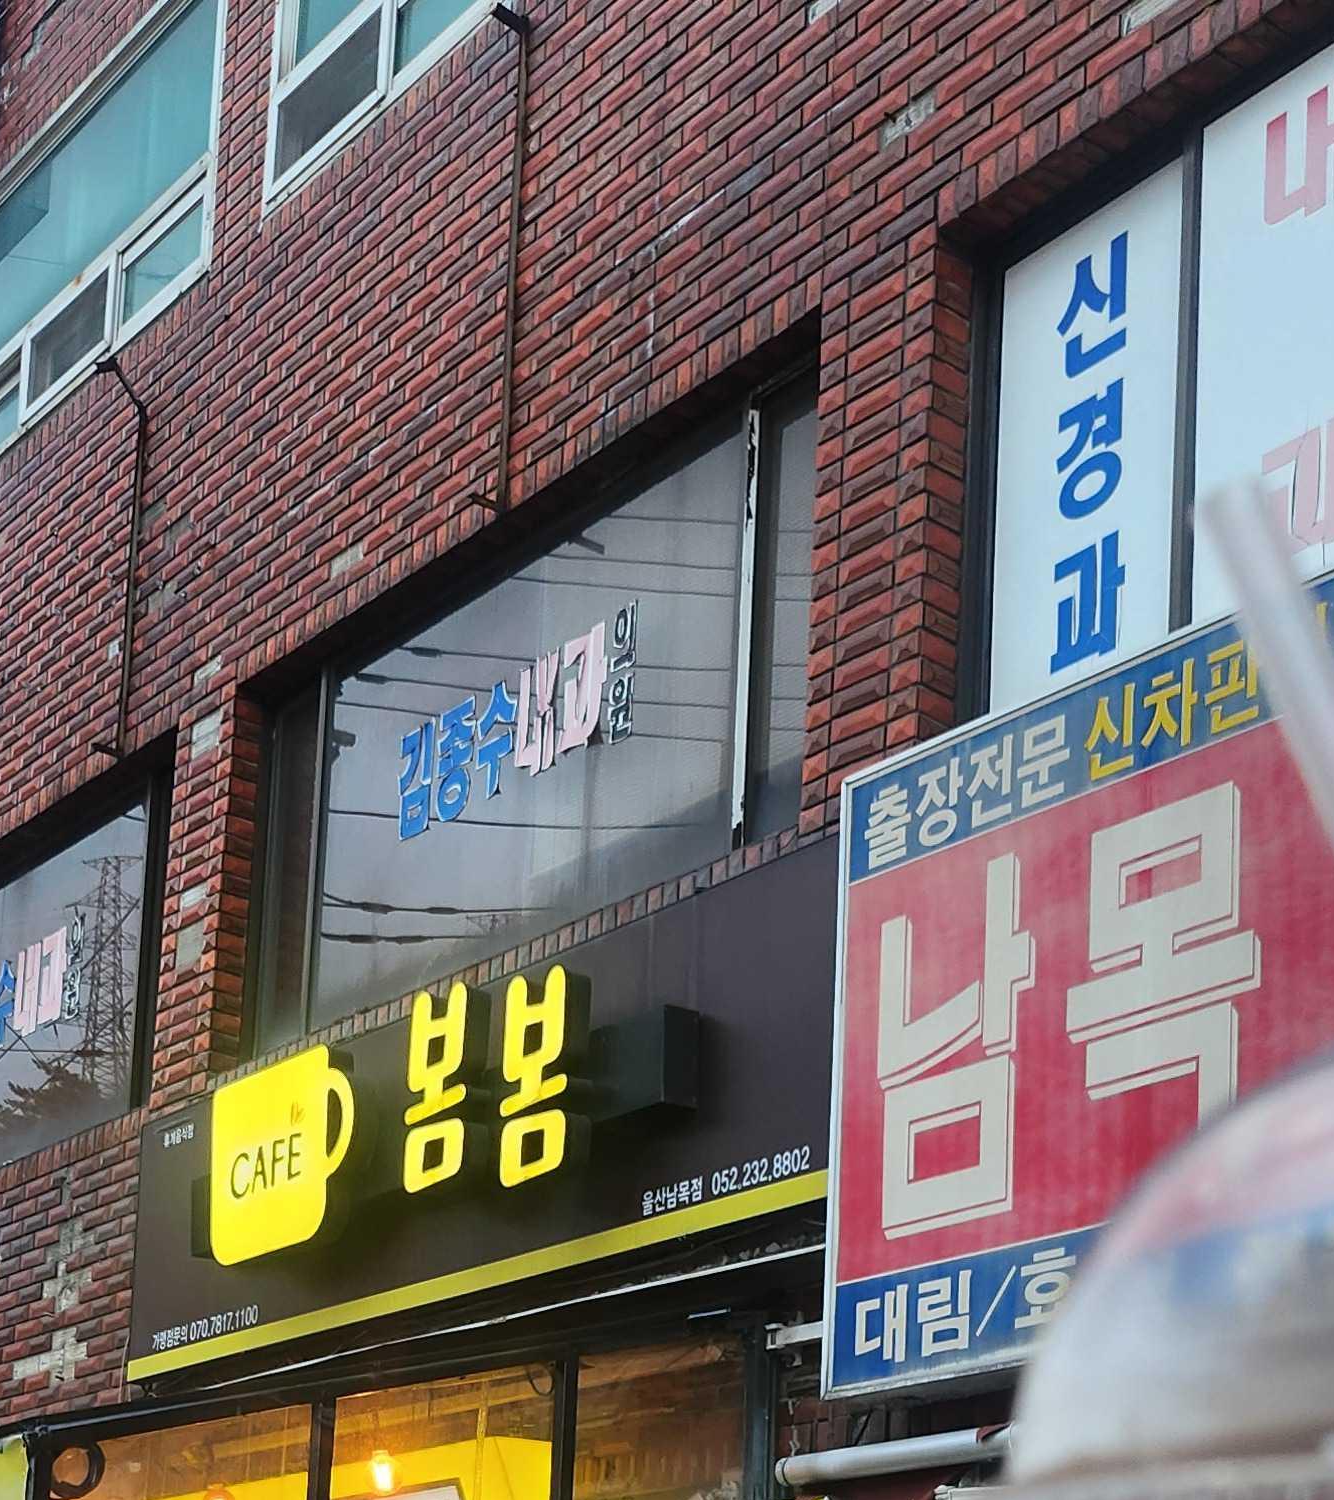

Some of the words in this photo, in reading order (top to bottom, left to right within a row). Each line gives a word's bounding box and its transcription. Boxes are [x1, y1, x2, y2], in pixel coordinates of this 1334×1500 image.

[1050, 230, 1127, 675] 신경과
[864, 714, 1070, 867] 출장전문
[404, 963, 569, 1194] 봄봄
[230, 1132, 303, 1199] CAFE
[642, 1176, 703, 1216] 울산남목점
[711, 1145, 811, 1196] 052.232.8802
[152, 1320, 189, 1351] 가맹점문의
[189, 1304, 259, 1341] 070.7817.1100
